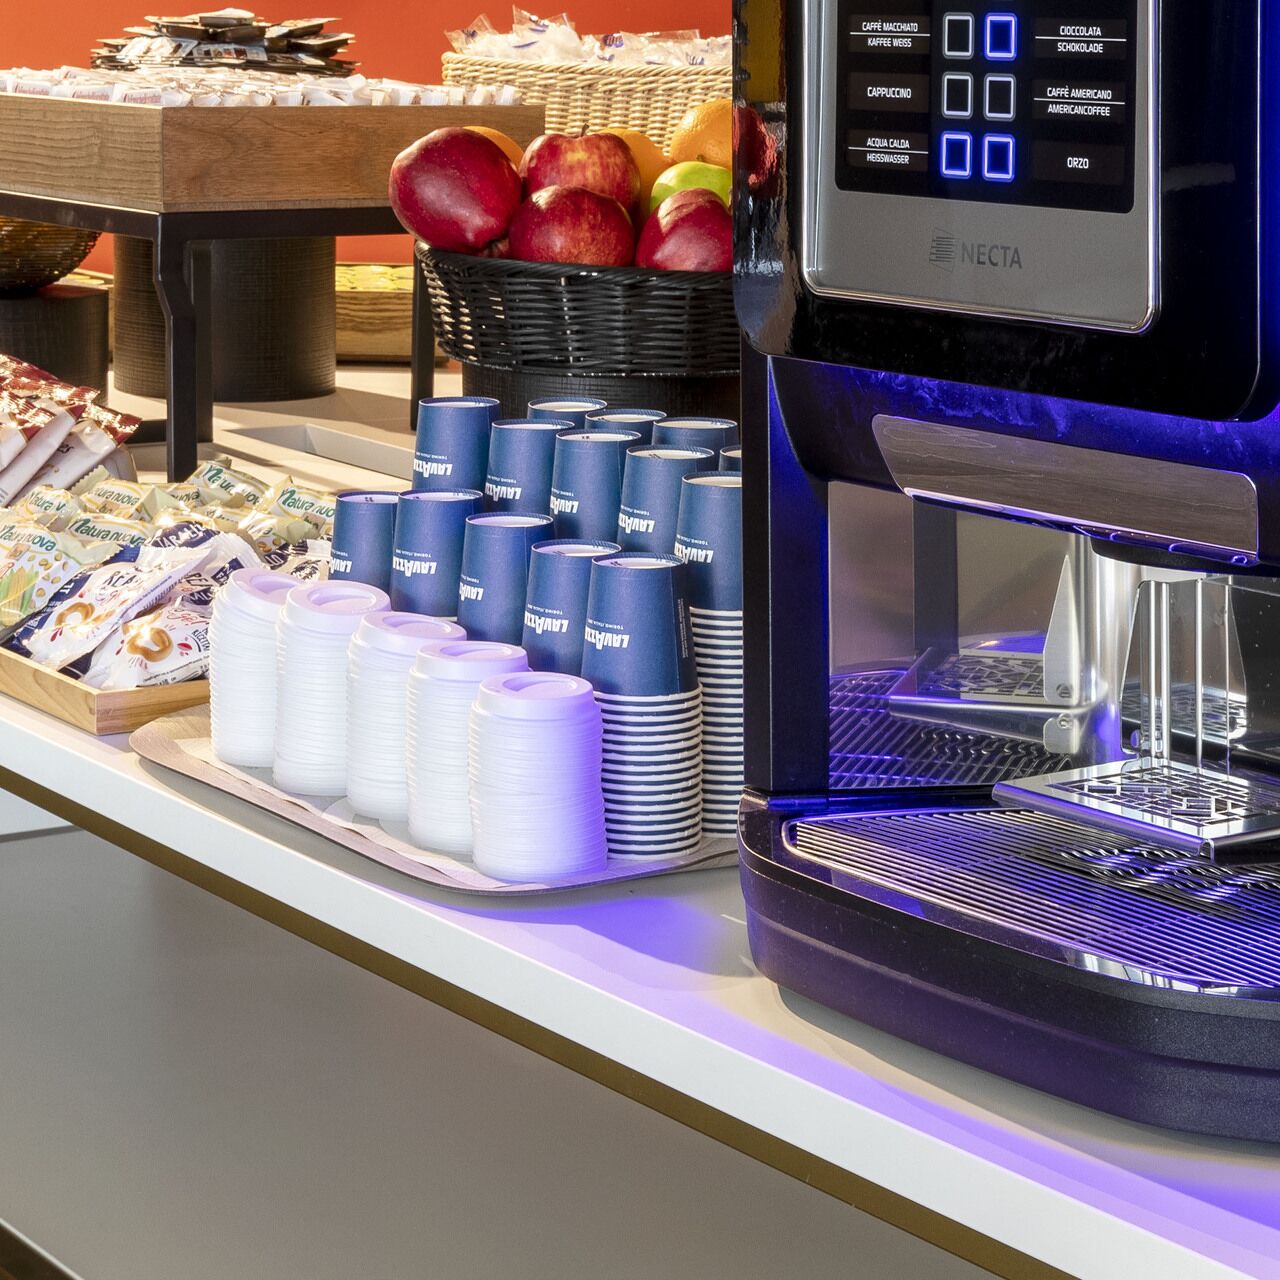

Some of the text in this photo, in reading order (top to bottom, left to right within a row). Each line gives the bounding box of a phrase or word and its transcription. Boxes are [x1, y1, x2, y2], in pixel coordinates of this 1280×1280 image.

[861, 21, 918, 32] CAFFÈ MACCHIATO
[1059, 26, 1102, 37] CIOCCOLATA
[867, 37, 912, 47] KAFFEE WEISS
[1057, 42, 1104, 53] SCHOKOLADE
[867, 87, 912, 99] CAPPUCCINO
[1046, 86, 1112, 100] CAFFÈ AMERICANO
[866, 137, 910, 149] ACQUA CALDA
[866, 154, 910, 164] HEISSWASSER
[1067, 157, 1089, 169] ORZO
[961, 243, 1022, 269] NECTA
[413, 459, 452, 478] LAVAZZ
[485, 482, 522, 502] LAVAZZ
[313, 504, 336, 518] nuo
[393, 556, 437, 577] LAVAZZ
[524, 611, 569, 634] LAVAZZ
[585, 626, 630, 650] LAVAZZ
